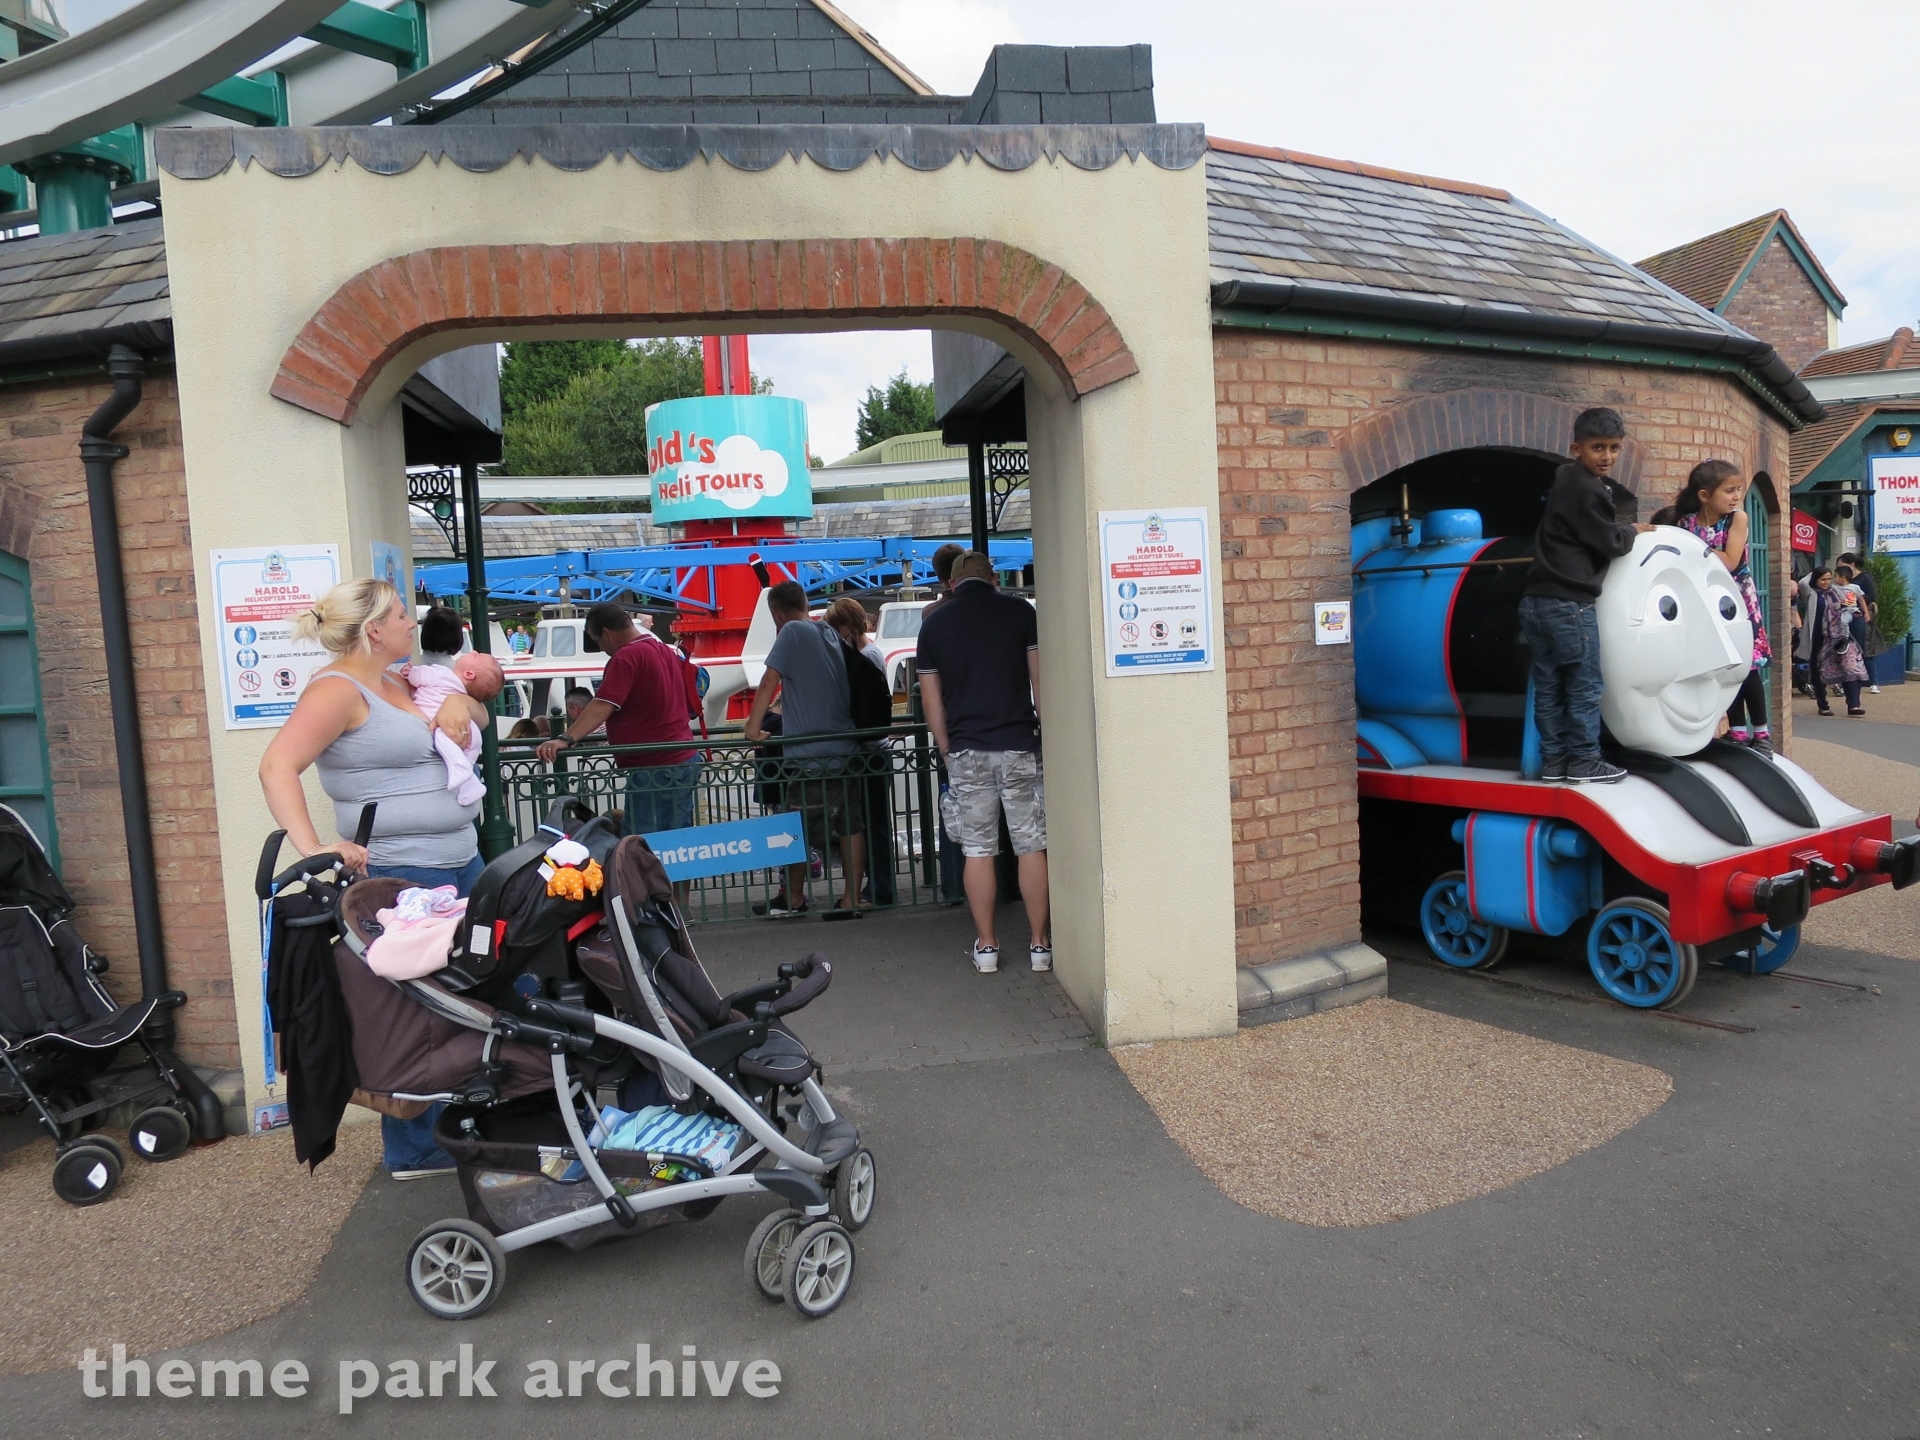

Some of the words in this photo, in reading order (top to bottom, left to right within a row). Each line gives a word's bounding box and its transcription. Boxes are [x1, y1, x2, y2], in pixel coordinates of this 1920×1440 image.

[659, 474, 691, 499] Heli
[696, 472, 764, 493] Tours
[1878, 476, 1919, 489] THOM
[1896, 496, 1915, 504] Take
[1136, 545, 1174, 554] HAROLD
[255, 586, 299, 595] HAROLD
